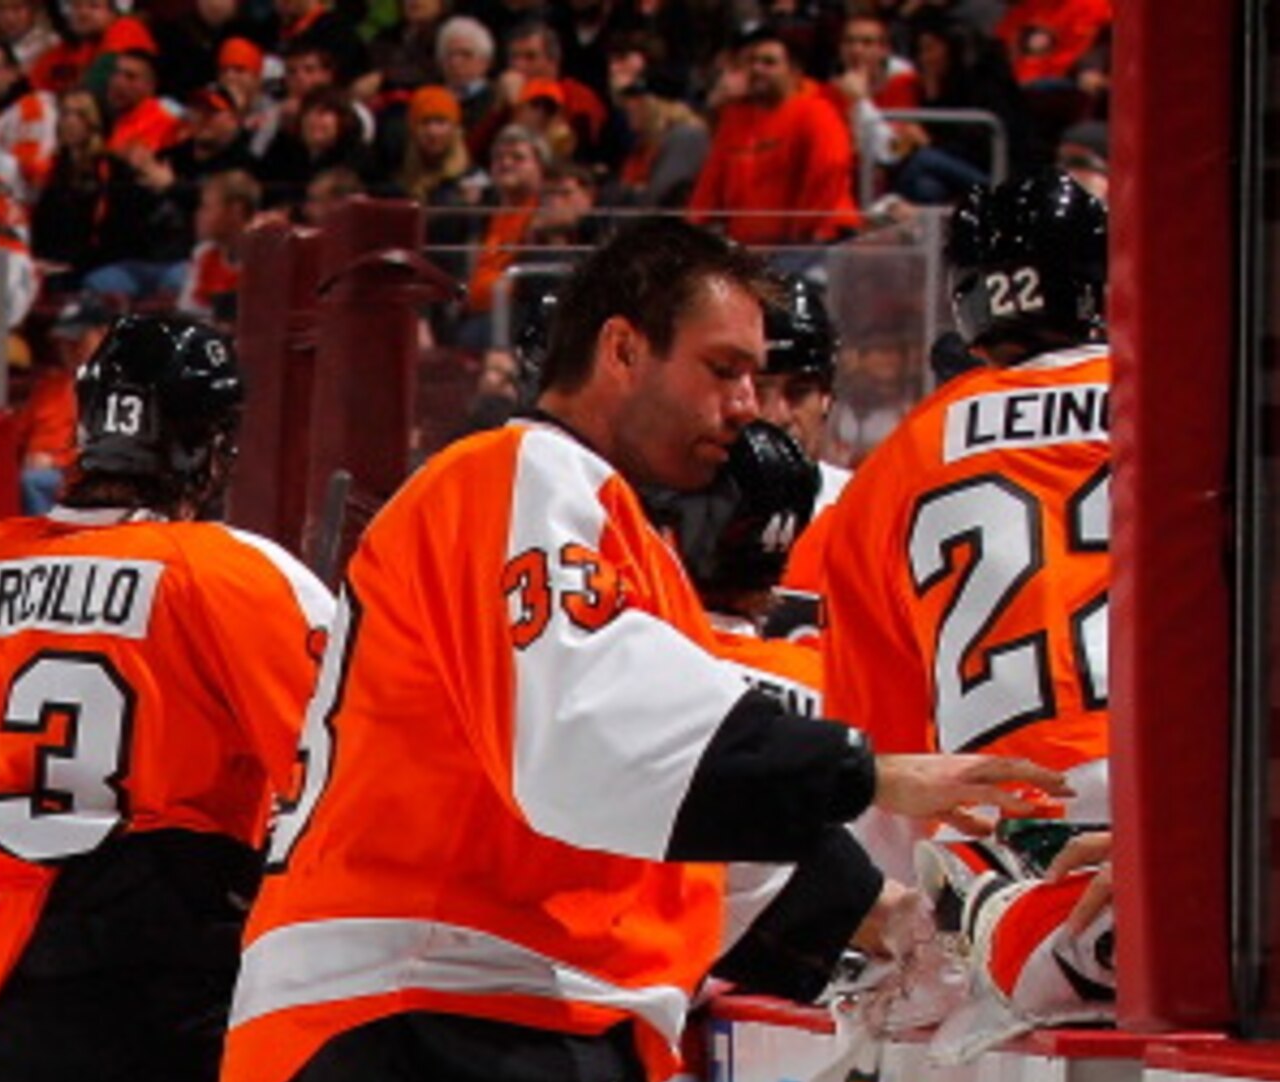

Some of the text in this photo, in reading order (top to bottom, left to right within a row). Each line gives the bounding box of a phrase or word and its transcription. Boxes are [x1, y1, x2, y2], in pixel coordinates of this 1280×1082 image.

[986, 266, 1045, 316] 22
[103, 392, 144, 436] 13
[965, 387, 1109, 449] LEIN
[502, 545, 621, 651] 33
